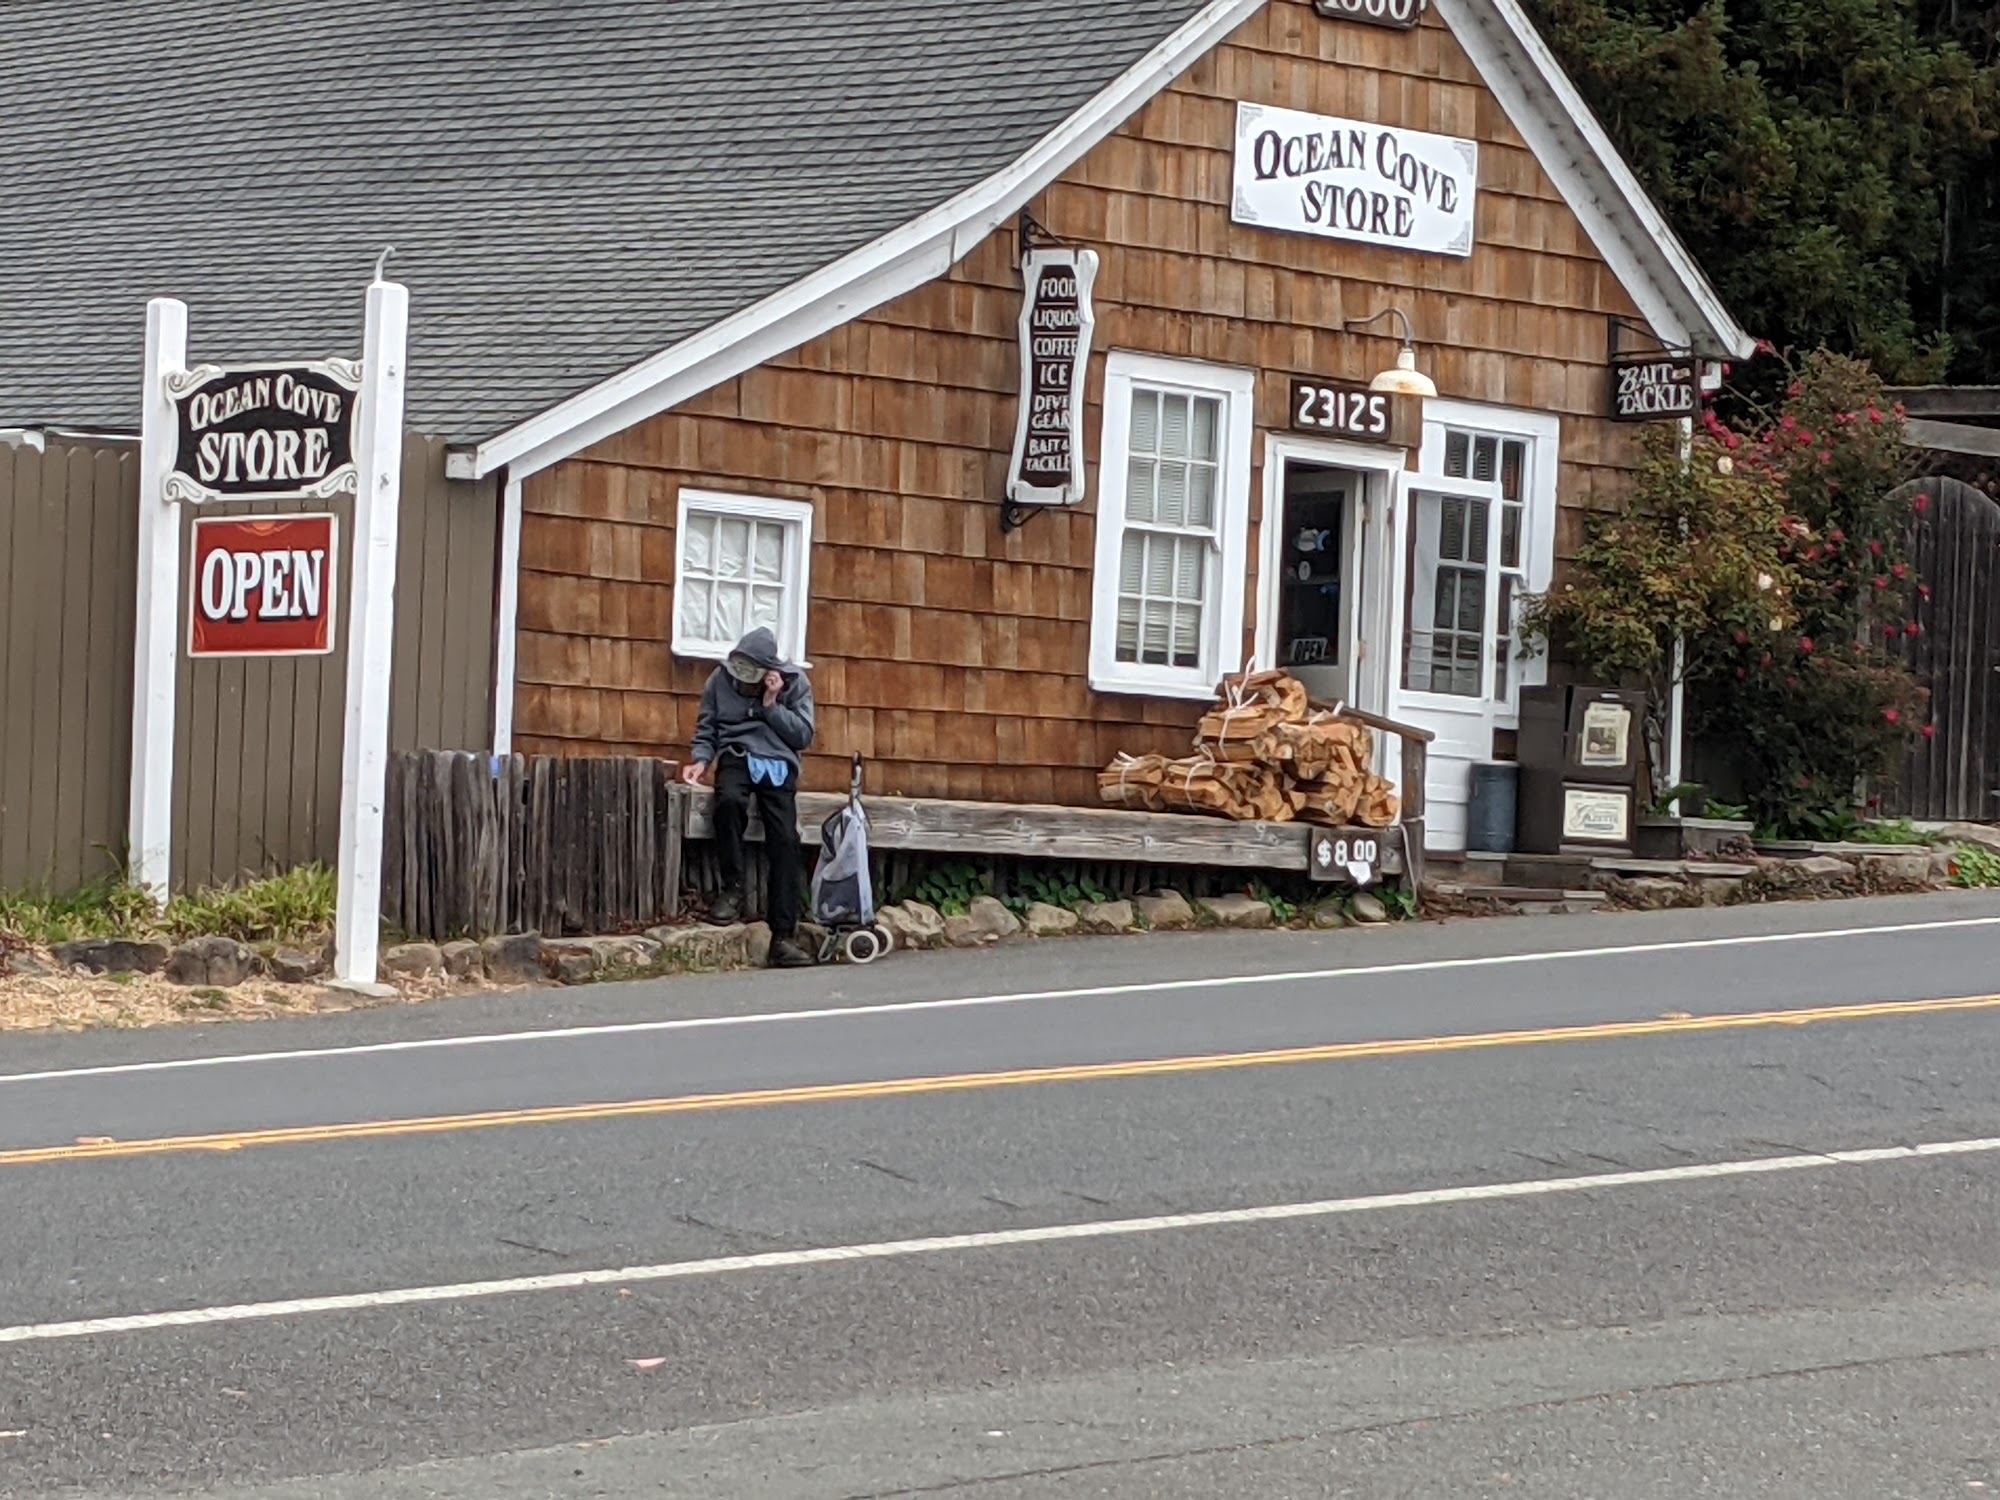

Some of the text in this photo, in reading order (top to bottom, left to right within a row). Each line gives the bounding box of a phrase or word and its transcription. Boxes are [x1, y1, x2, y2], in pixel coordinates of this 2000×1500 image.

[1254, 129, 1459, 213] OCEAN COVE
[1301, 180, 1415, 237] STORE
[1040, 278, 1077, 298] FOOD
[1034, 338, 1077, 357] COFFEE
[1041, 363, 1068, 385] ICE
[1617, 363, 1673, 394] BAIT
[189, 373, 342, 431] OCEAN COVE
[1034, 394, 1069, 412] DIVE
[1298, 385, 1386, 433] 23125
[1617, 384, 1694, 415] TACKLE
[1031, 410, 1071, 430] GEAR
[195, 428, 332, 482] STORE
[1029, 438, 1060, 456] BAIT
[1025, 453, 1071, 472] TACKLE
[201, 547, 324, 620] OPEN
[1294, 640, 1325, 662] OPEN
